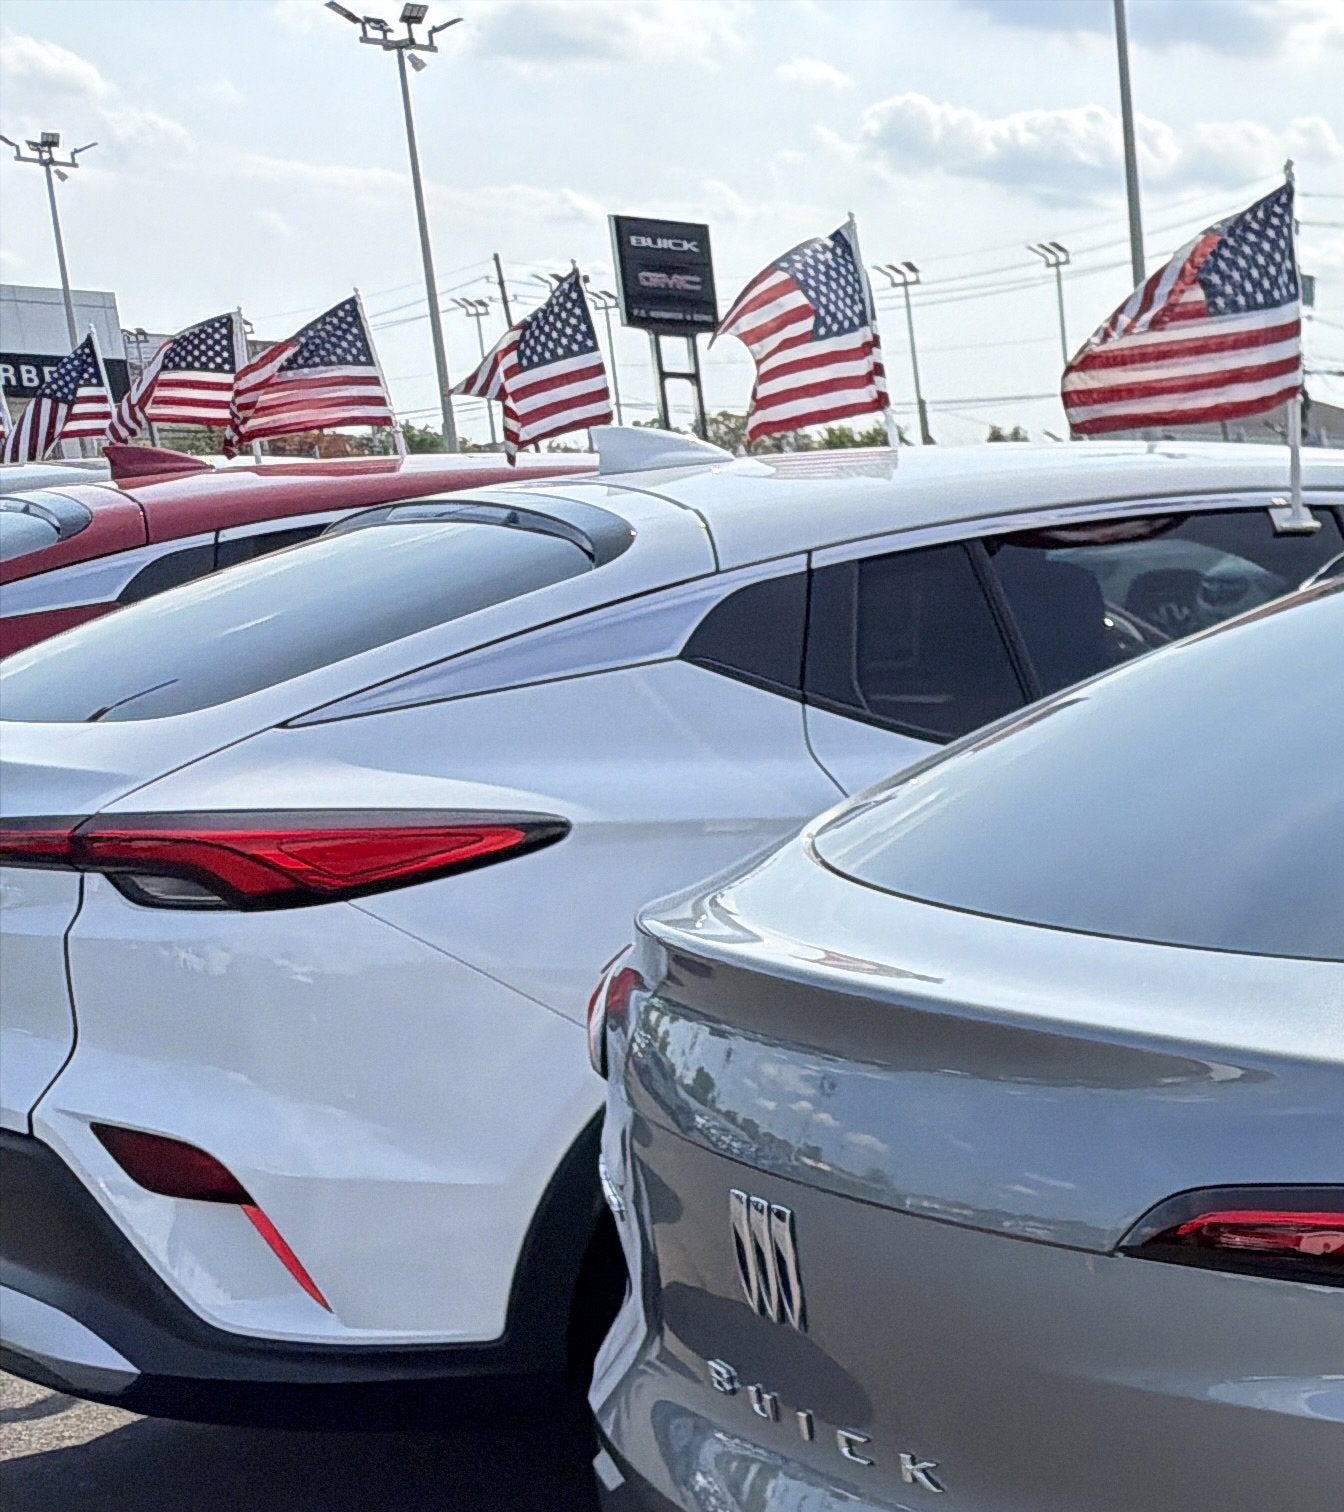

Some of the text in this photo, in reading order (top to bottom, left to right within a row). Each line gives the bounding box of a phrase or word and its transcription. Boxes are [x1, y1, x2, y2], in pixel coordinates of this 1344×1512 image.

[629, 235, 700, 252] BUICK
[638, 271, 702, 290] GMC
[707, 1358, 947, 1493] BUICK
